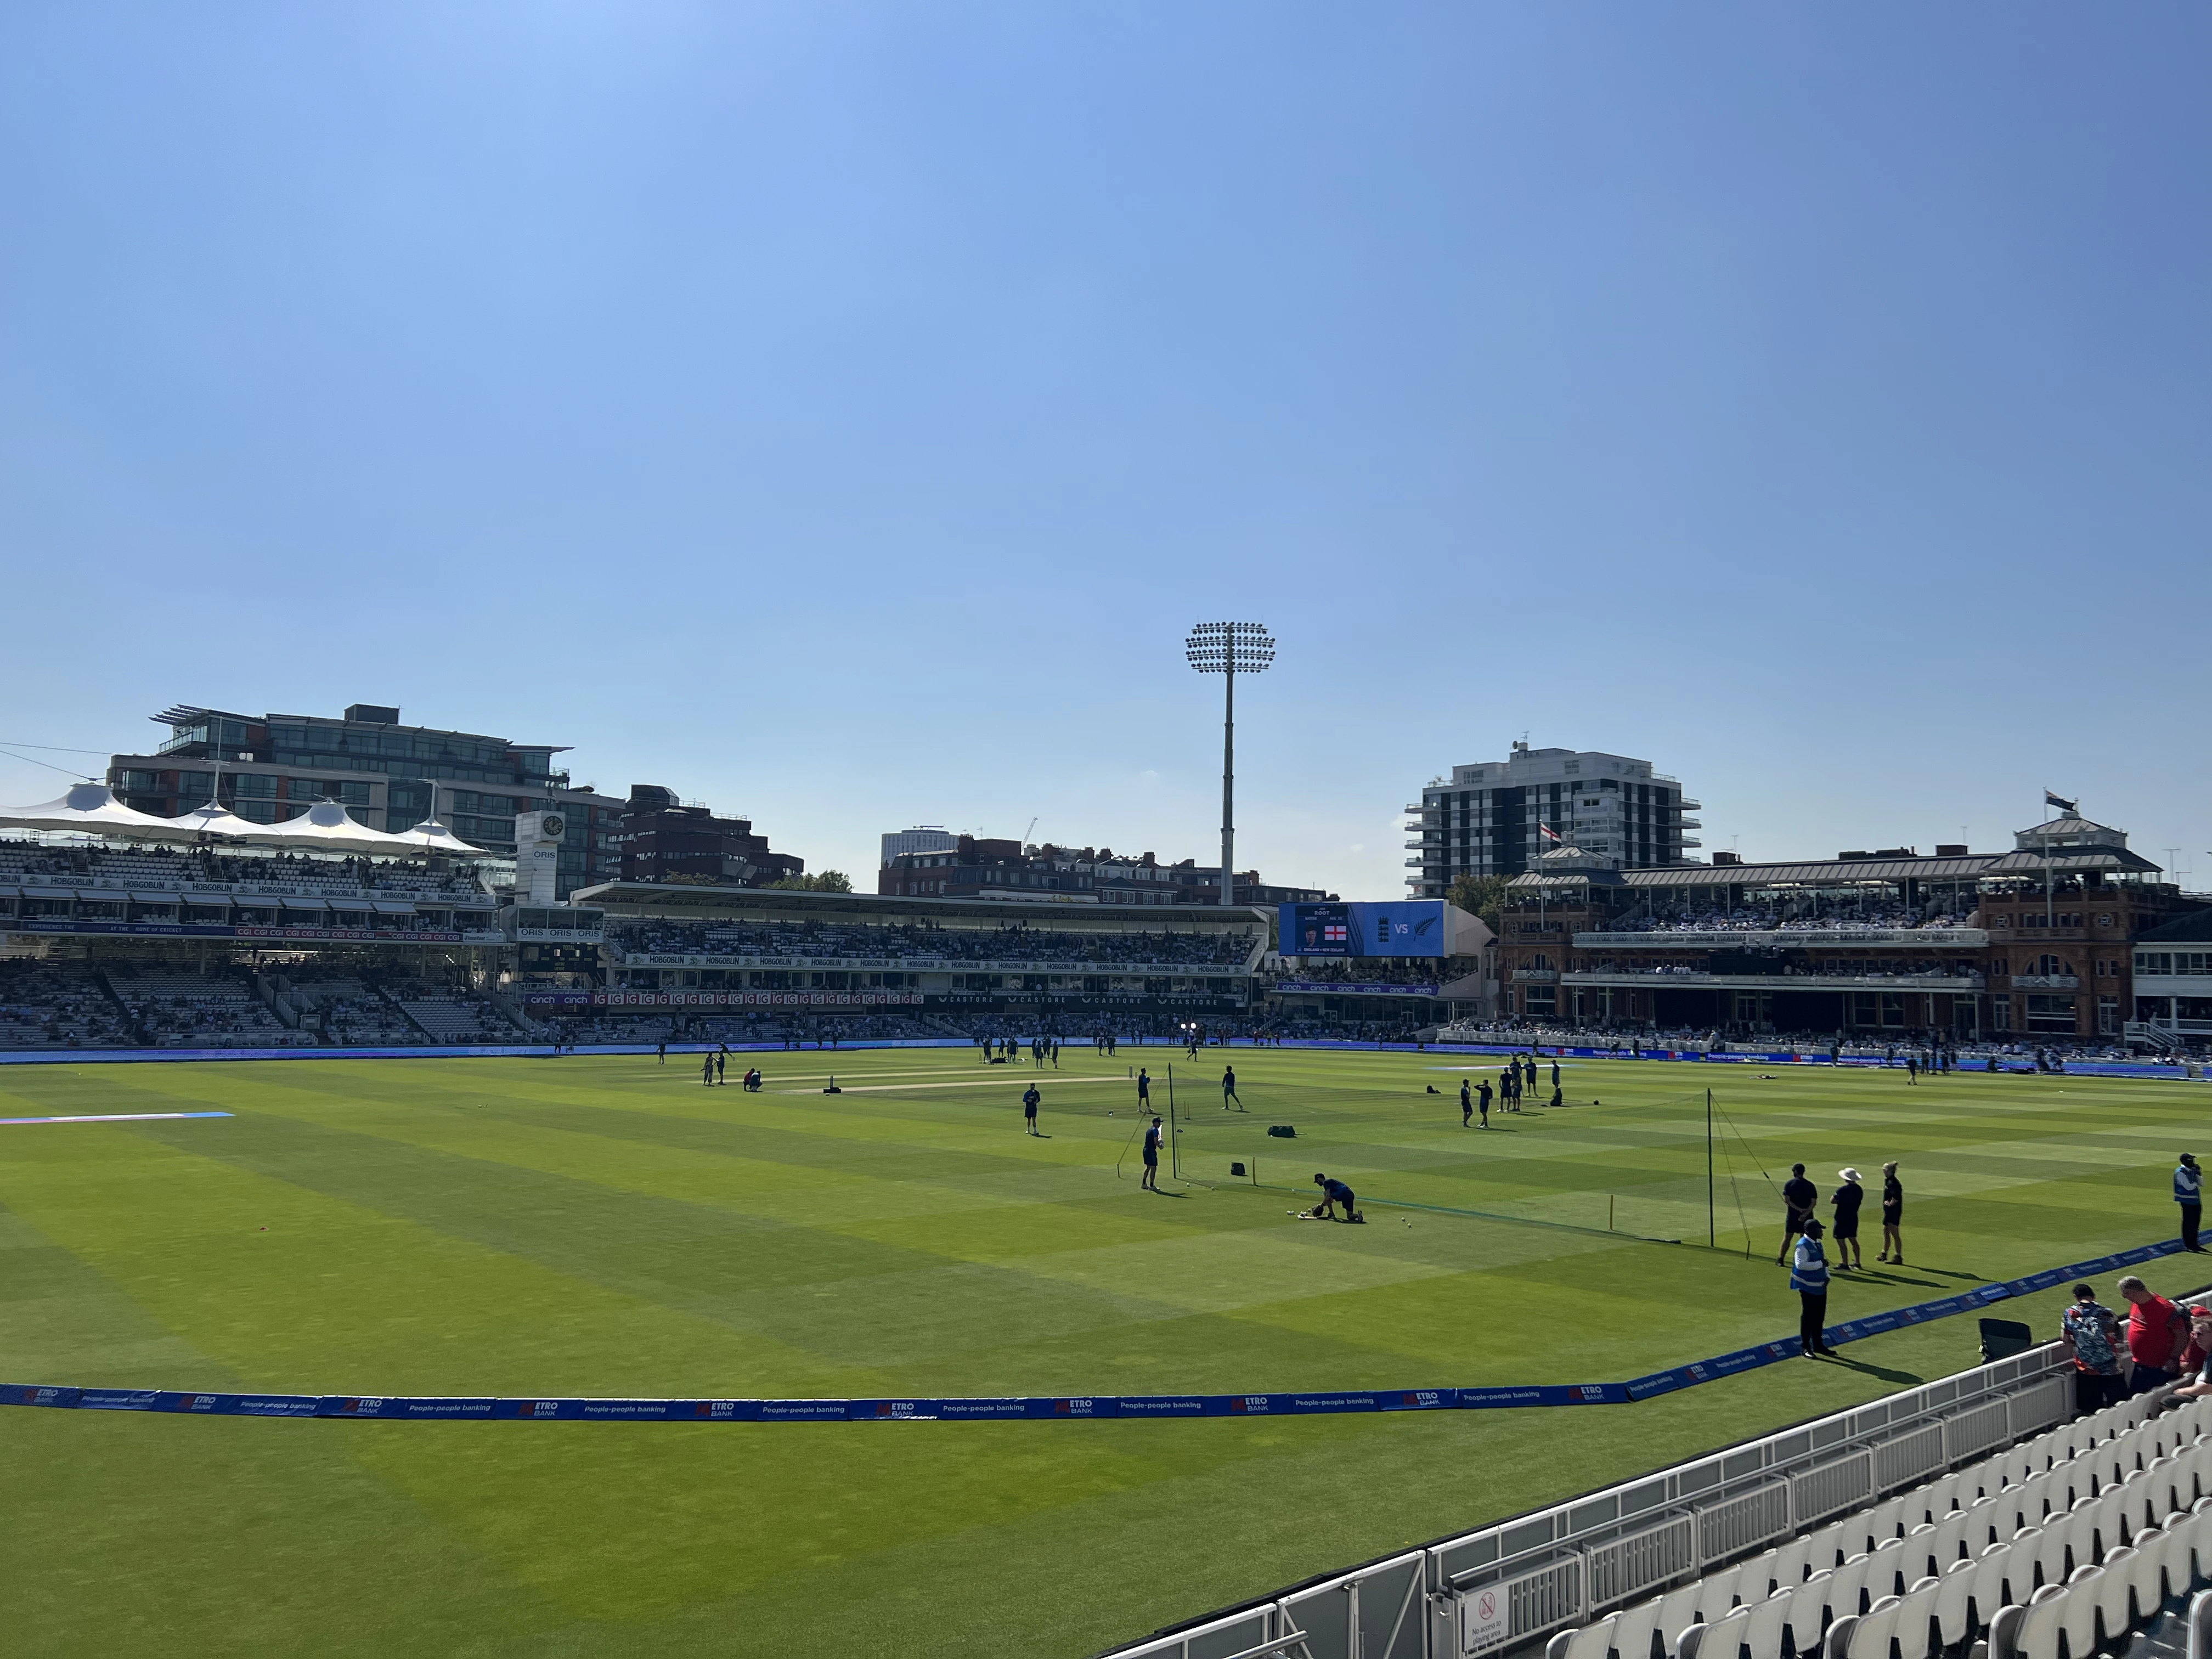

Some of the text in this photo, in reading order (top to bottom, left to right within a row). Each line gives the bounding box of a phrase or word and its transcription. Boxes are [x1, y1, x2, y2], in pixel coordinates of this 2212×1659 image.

[50, 877, 94, 886] HOBGOBLIN
[123, 879, 165, 889] HOBGOBLIN
[193, 882, 232, 892] HOBGOBLIN
[258, 885, 296, 895] HOBGOBLIN
[321, 888, 357, 898] HOBGOBLIN
[381, 891, 415, 900] HOBGOBLIN
[438, 893, 471, 902] HOBGOBLIN
[1395, 924, 1408, 934] VS
[650, 956, 684, 964] HOBGOBLIN
[706, 956, 739, 964] HOBGOBLIN
[760, 957, 791, 966] HOBGOBLIN
[860, 959, 889, 967] HOBGOBLIN
[951, 961, 980, 969] HOBGOBLIN
[998, 961, 1027, 969] HOBGOBLIN
[1047, 962, 1076, 970] HOBGOBLIN
[1198, 965, 1229, 973] HOBGOBLIN
[595, 995, 922, 1003] IG IG IG IG IG IG IG IG IG IG IG IG IG IG IG IG IG IG IG IG IG IG IG IG
[462, 1404, 490, 1413] banking
[1480, 1622, 1496, 1633] access
[1473, 1629, 1500, 1646] playing area
